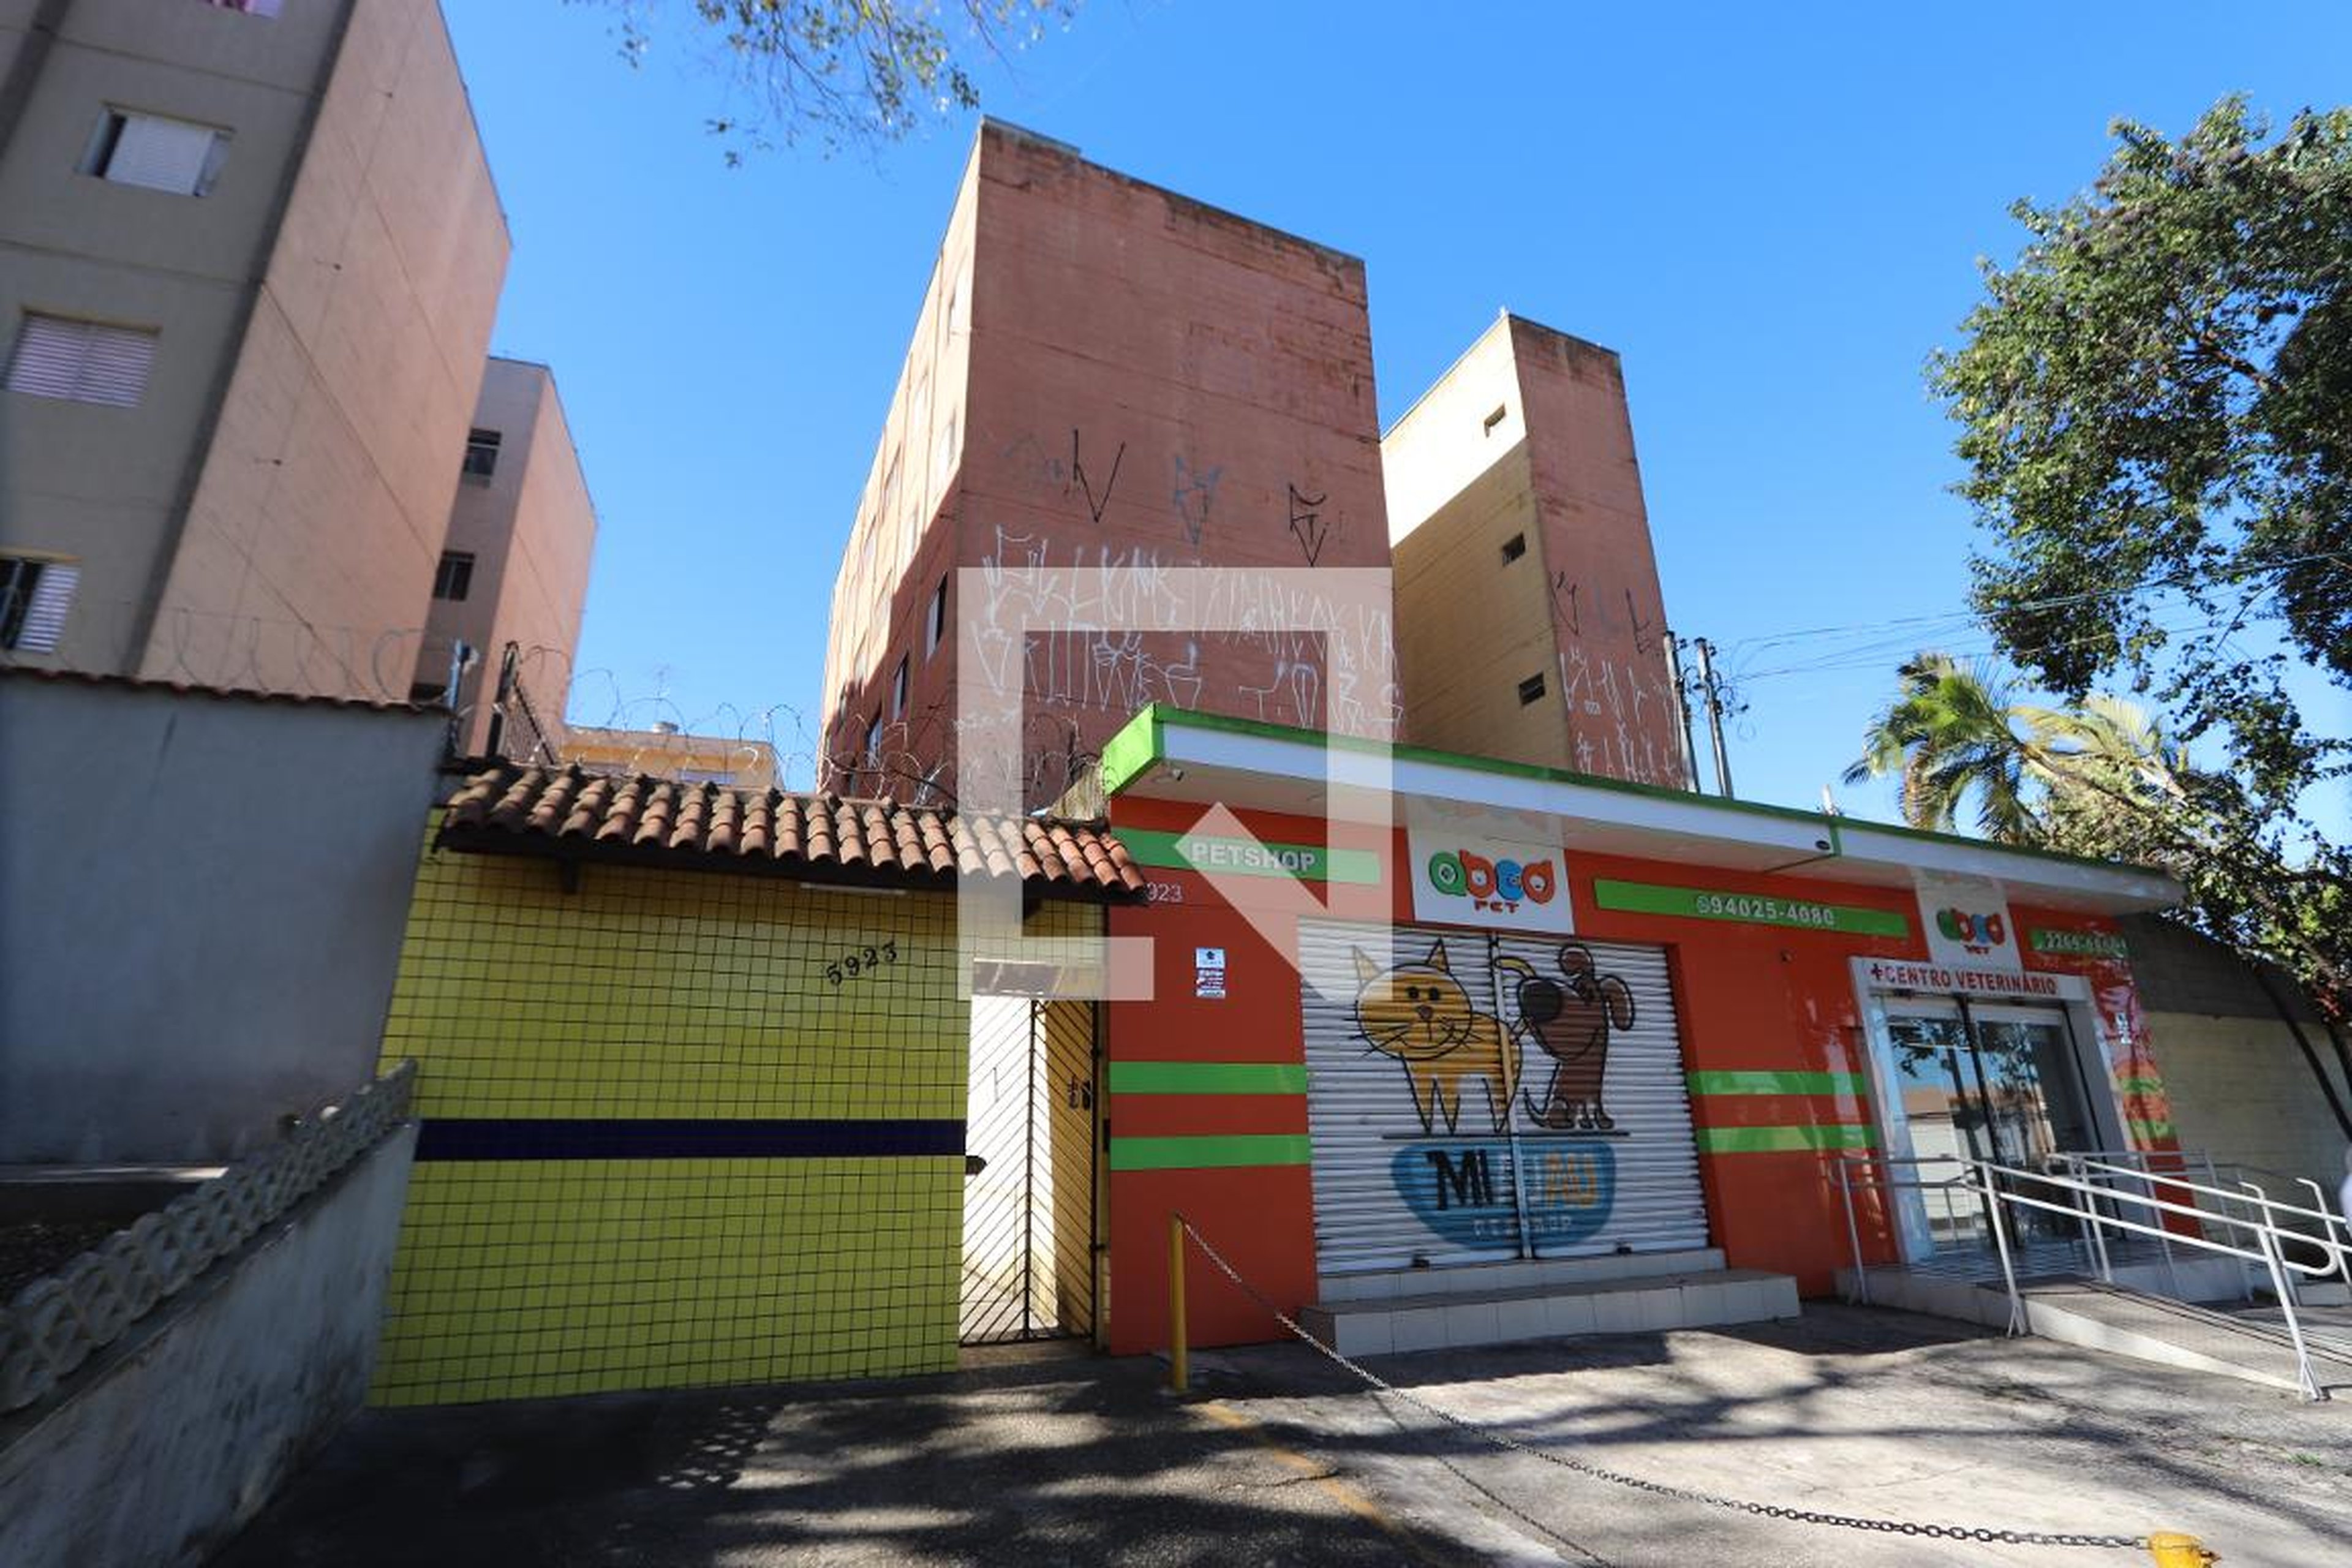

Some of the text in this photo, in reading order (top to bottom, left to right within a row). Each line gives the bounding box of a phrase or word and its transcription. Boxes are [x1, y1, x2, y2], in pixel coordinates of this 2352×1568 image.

[1191, 842, 1316, 872] PETSHOP
[1474, 899, 1520, 913] PET
[1711, 895, 1835, 925] 94025-4080
[826, 941, 897, 986] 5923
[1883, 966, 2057, 994] CENTRO VETERINÁRIO
